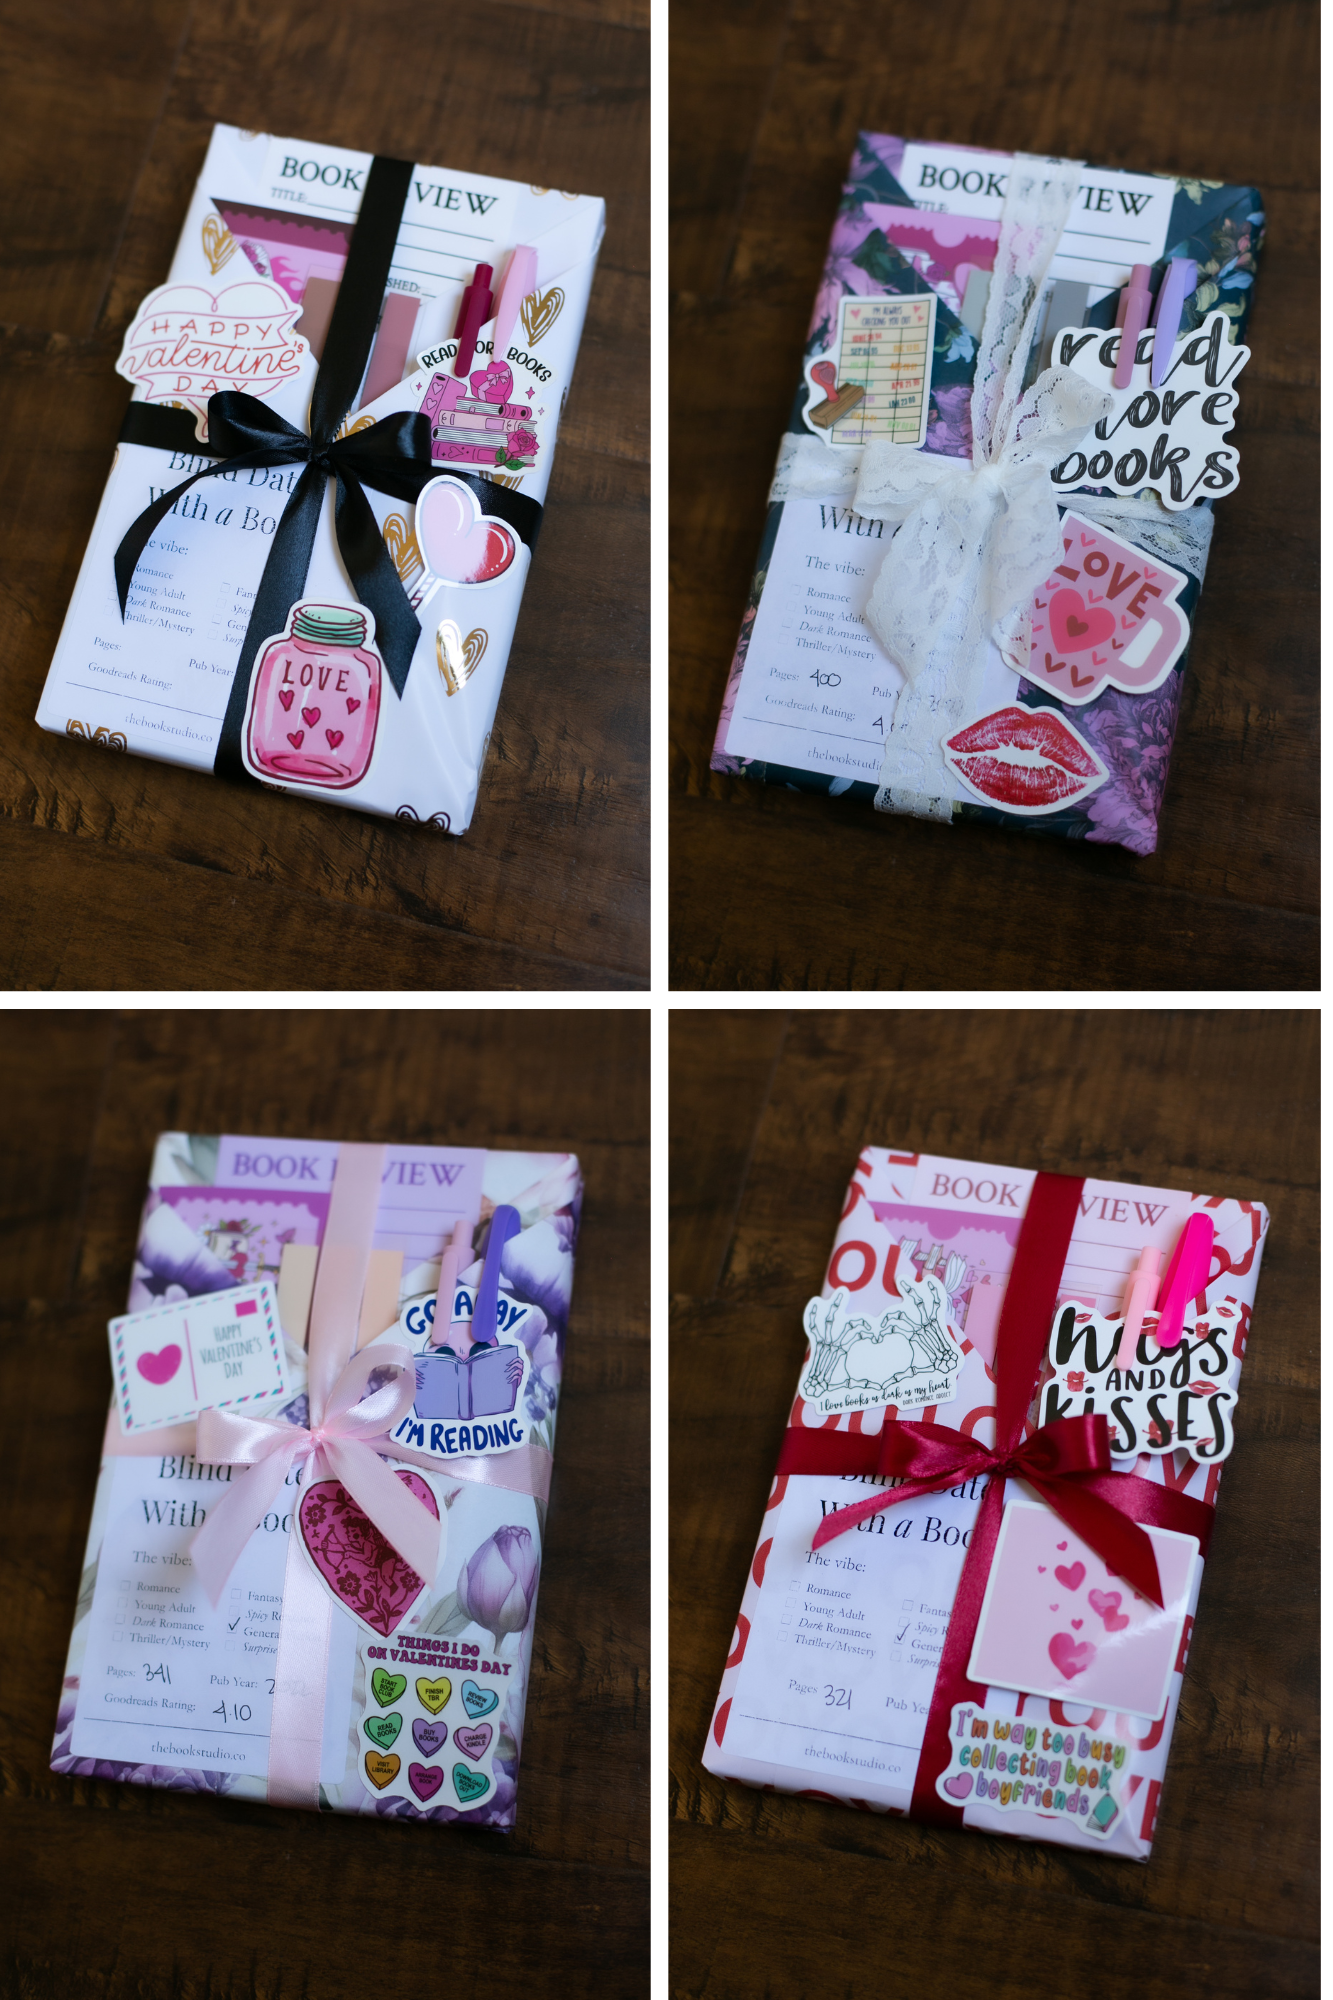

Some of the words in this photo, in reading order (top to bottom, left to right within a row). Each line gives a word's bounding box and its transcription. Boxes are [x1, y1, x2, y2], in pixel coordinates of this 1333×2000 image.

[280, 156, 365, 191] BOOK
[409, 181, 499, 216] VIEW
[918, 164, 1008, 198] BOOK
[152, 319, 272, 340] HAPPY
[507, 347, 552, 382] BOOKS
[215, 507, 234, 526] a
[160, 540, 189, 555] vibe:
[134, 564, 174, 580] Romance
[805, 555, 830, 571] The
[835, 561, 866, 576] vibe:
[129, 581, 157, 596] Young
[161, 586, 186, 601] Adult
[806, 587, 851, 603] Romance
[126, 595, 147, 608] Dark
[150, 601, 192, 618] Romance
[804, 605, 835, 621] Young
[838, 612, 865, 625] Adult
[799, 621, 824, 634] Dark
[827, 626, 872, 643] Romance
[94, 636, 122, 652] Pages:
[795, 636, 877, 663] Thriller/Mystery
[88, 662, 137, 682] Goodreads
[140, 674, 173, 690] Rating:
[189, 658, 208, 672] Pub
[210, 664, 234, 678] Year:
[282, 659, 350, 692] LOVE
[769, 667, 800, 682] Pages:
[809, 668, 842, 688] 400
[872, 686, 892, 699] Pub
[765, 694, 818, 713] Goodreads
[821, 704, 856, 722] Rating:
[125, 713, 213, 743] thebookstudio.co
[232, 1153, 320, 1181] BOOK
[930, 1173, 1022, 1208] BOOK
[1079, 1194, 1170, 1227] VIEW
[213, 1323, 242, 1342] HAPPY
[200, 1337, 263, 1365] VALENTINE'S
[223, 1361, 243, 1379] DAY
[1105, 1367, 1166, 1391] AND
[825, 1399, 843, 1411] love
[845, 1394, 869, 1407] books
[881, 1387, 903, 1400] dark
[914, 1386, 927, 1397] my
[395, 1417, 424, 1447] I'M
[430, 1418, 524, 1454] READING
[142, 1499, 206, 1528] With
[894, 1518, 913, 1539] a
[133, 1551, 158, 1564] The
[161, 1552, 192, 1566] vibe:
[805, 1551, 831, 1566] The
[835, 1557, 866, 1573] vibe:
[137, 1581, 181, 1594] Romance
[806, 1583, 852, 1600] Romance
[135, 1599, 165, 1613] Young
[168, 1600, 196, 1613] Adult
[245, 1609, 268, 1622] Spicy
[803, 1602, 834, 1618] Young
[838, 1607, 866, 1621] Adult
[919, 1604, 951, 1617] Fantas
[132, 1616, 157, 1627] Dark
[159, 1618, 204, 1632] Romance
[243, 1627, 279, 1639] Genera
[799, 1618, 823, 1631] Dark
[826, 1622, 872, 1640] Romance
[914, 1621, 939, 1635] Spicy
[129, 1632, 210, 1650] Thriller/Mystery
[397, 1635, 451, 1653] THINGS
[451, 1642, 458, 1654] I
[460, 1643, 480, 1656] DO
[794, 1634, 877, 1659] Thriller/Mystery
[367, 1646, 387, 1660] ON
[390, 1649, 478, 1672] VALENTINES
[480, 1660, 512, 1676] DAY
[907, 1654, 940, 1669] Surpris
[106, 1665, 136, 1679] Pages:
[143, 1662, 171, 1685] 341
[210, 1674, 230, 1686] Pub
[233, 1676, 258, 1689] Year:
[379, 1683, 395, 1693] BOOK
[380, 1677, 398, 1688] START
[104, 1692, 158, 1708] Goodreads
[161, 1698, 196, 1712] Rating:
[378, 1688, 392, 1698] CLUB
[465, 1696, 484, 1709] BOOKS
[467, 1691, 488, 1704] REVIEW
[824, 1685, 853, 1711] 321
[885, 1697, 907, 1711] Pub
[377, 1722, 394, 1731] READ
[377, 1728, 397, 1738] BOOKS
[423, 1728, 436, 1736] BUY
[418, 1734, 439, 1743] BOOKS
[463, 1733, 487, 1742] CHARGE
[466, 1739, 486, 1748] KINDLE
[956, 1708, 988, 1739] I'm
[993, 1720, 1037, 1750] way
[1042, 1728, 1075, 1753] too
[1078, 1731, 1127, 1769] busy
[151, 1741, 246, 1762] thebookstudio.co
[805, 1746, 901, 1773] thebookstudio.co
[372, 1766, 394, 1775] LIBRARY
[960, 1743, 1061, 1787] collecting
[1064, 1758, 1112, 1790] book
[976, 1771, 1089, 1815] boyfriends
